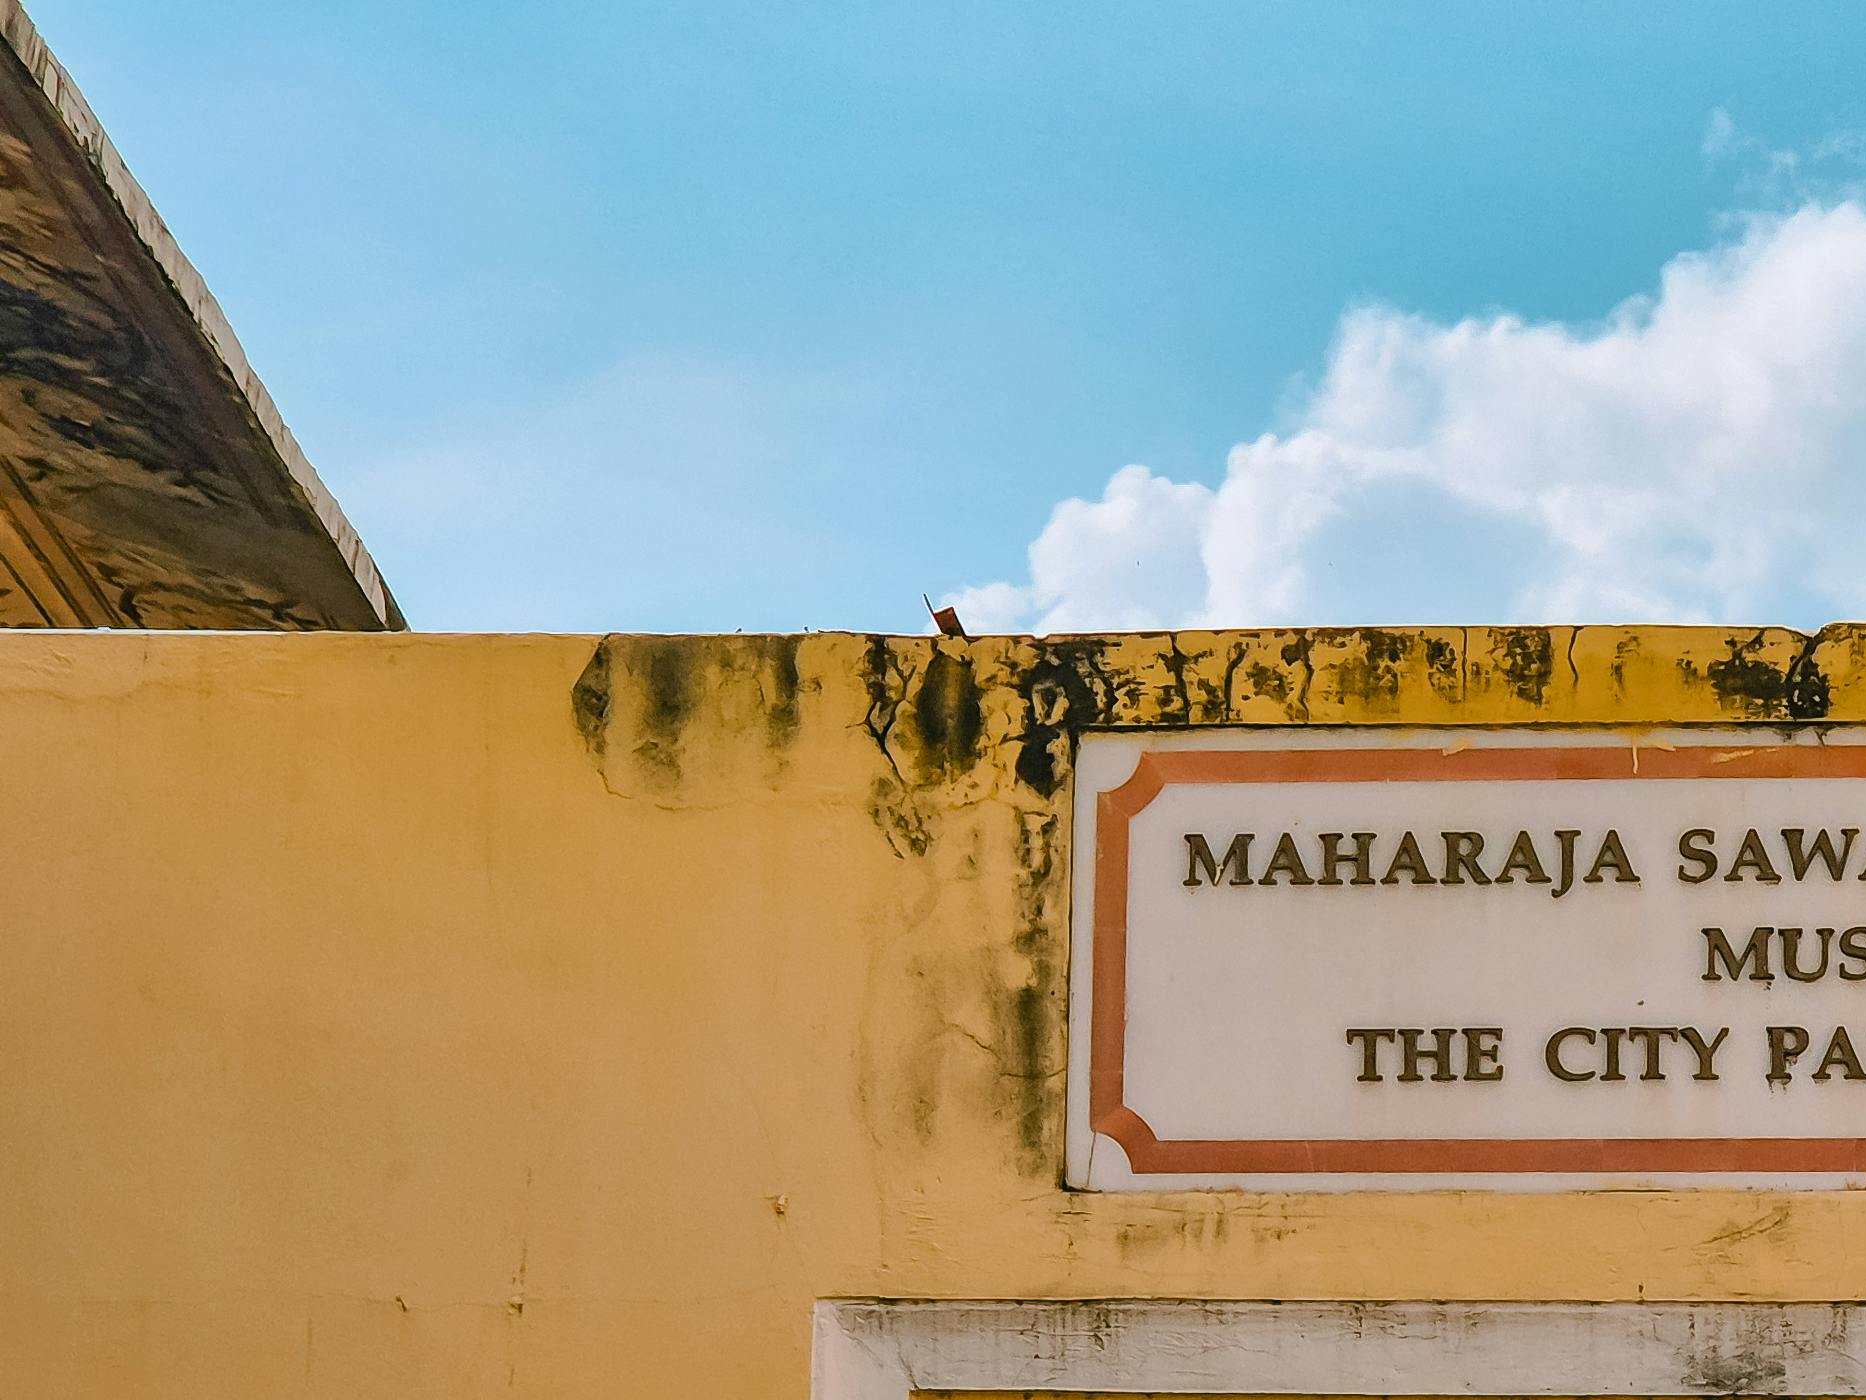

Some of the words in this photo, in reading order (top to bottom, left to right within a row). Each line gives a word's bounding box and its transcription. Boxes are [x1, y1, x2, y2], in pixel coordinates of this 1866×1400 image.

[1183, 828, 1641, 898] MAHARAJA
[1345, 1026, 1505, 1085] THE
[1544, 1025, 1731, 1084] CITY
